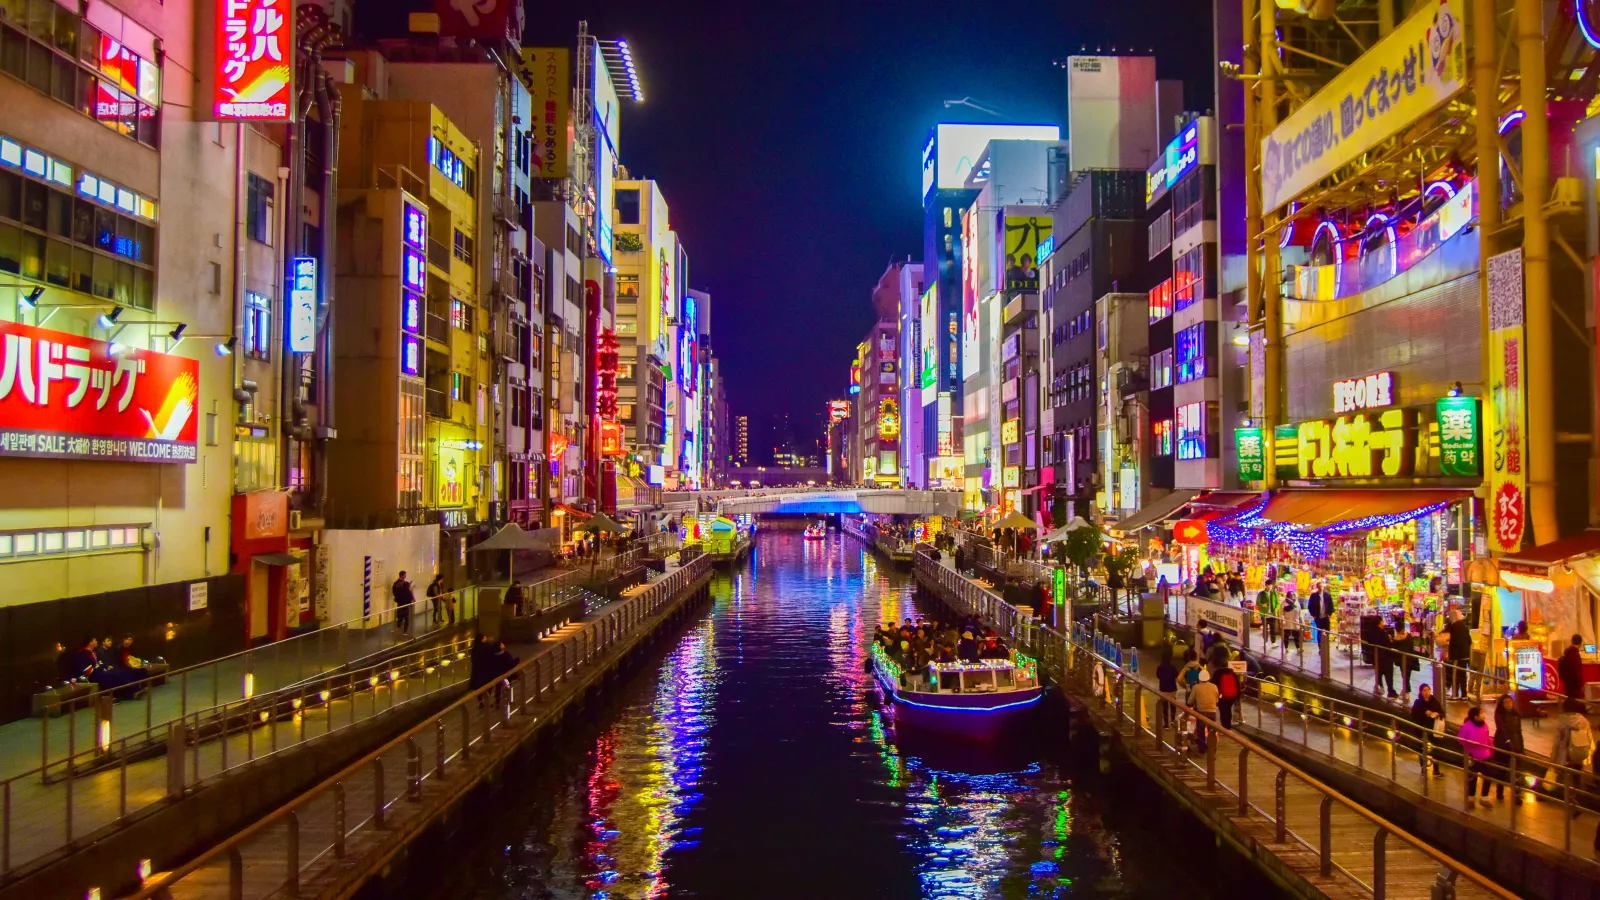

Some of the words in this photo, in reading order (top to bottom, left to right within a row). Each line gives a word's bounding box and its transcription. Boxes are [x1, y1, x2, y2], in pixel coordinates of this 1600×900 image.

[1441, 409, 1473, 441] 薬
[38, 434, 66, 453] SALE
[129, 441, 171, 459] WELCOME
